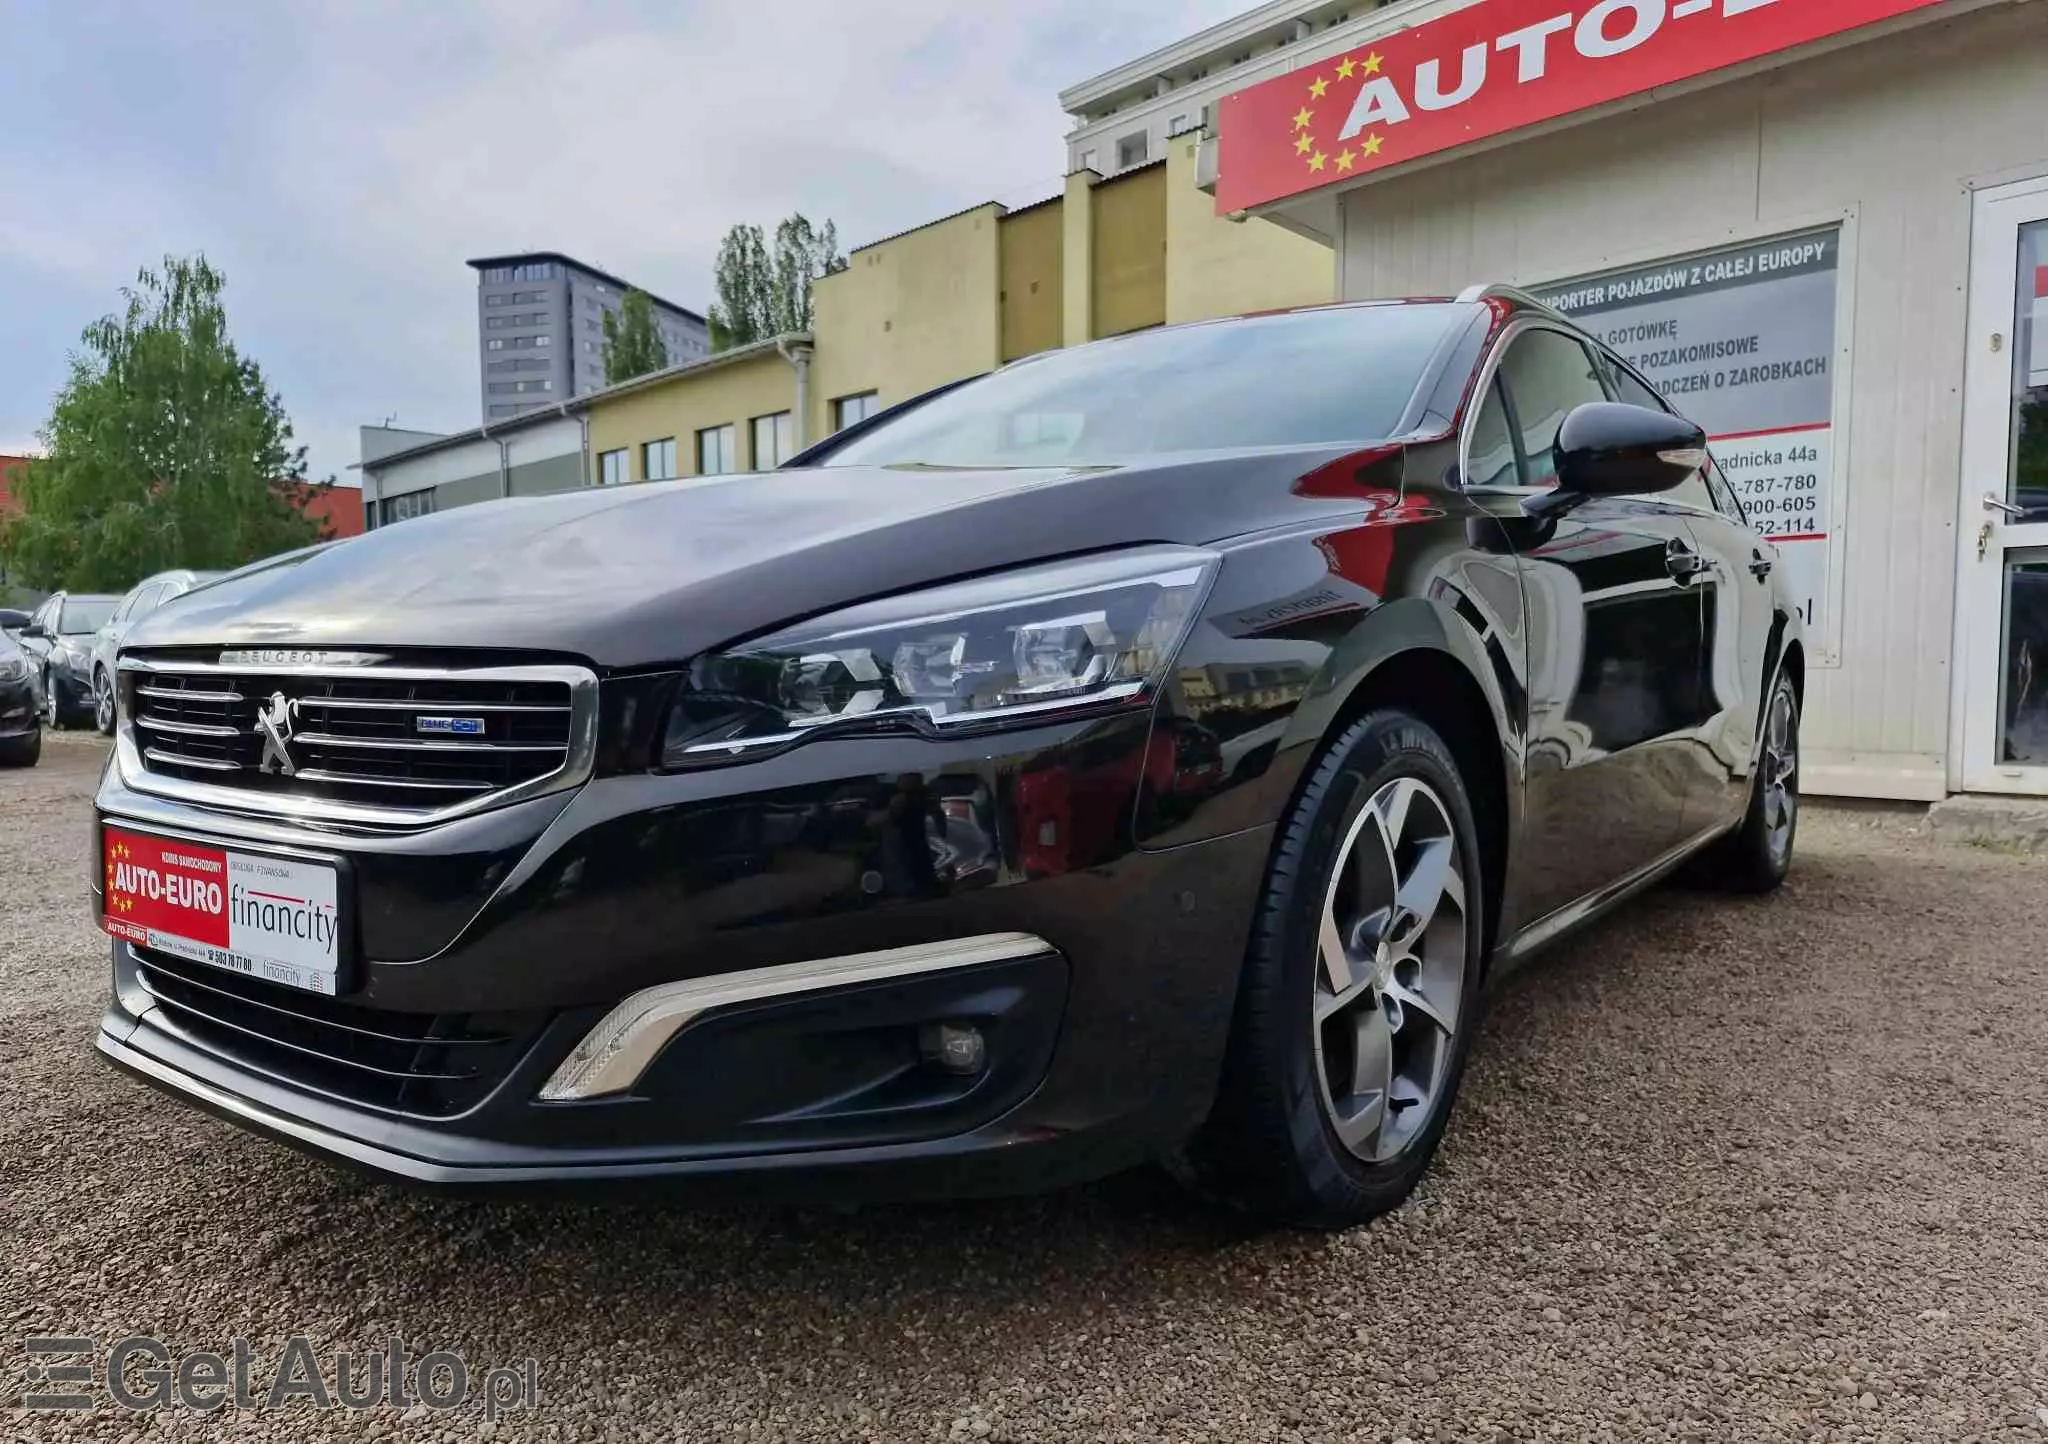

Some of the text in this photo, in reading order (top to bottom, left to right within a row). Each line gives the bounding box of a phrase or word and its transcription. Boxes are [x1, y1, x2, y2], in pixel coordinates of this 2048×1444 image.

[1337, 0, 1780, 141] AUTO-
[1607, 269, 1687, 302] POJAZDÓW
[1690, 266, 1702, 287] Z
[1704, 255, 1755, 283] CAŁEJ
[1758, 242, 1826, 273] EUROPY
[1607, 319, 1679, 346] GOTÓWKĘ
[1640, 336, 1760, 371] POZAKOMISOWE
[1653, 356, 1827, 397] ADCZEŃ O ZAROBKACH
[1717, 445, 1818, 474] ądnicka 44a
[1743, 495, 1816, 515] 900-605
[1755, 516, 1816, 536] 52-114
[239, 650, 328, 664] PEUGEOT
[115, 861, 222, 915] AUTO-EURO
[231, 883, 338, 954] financity
[263, 960, 301, 986] financity
